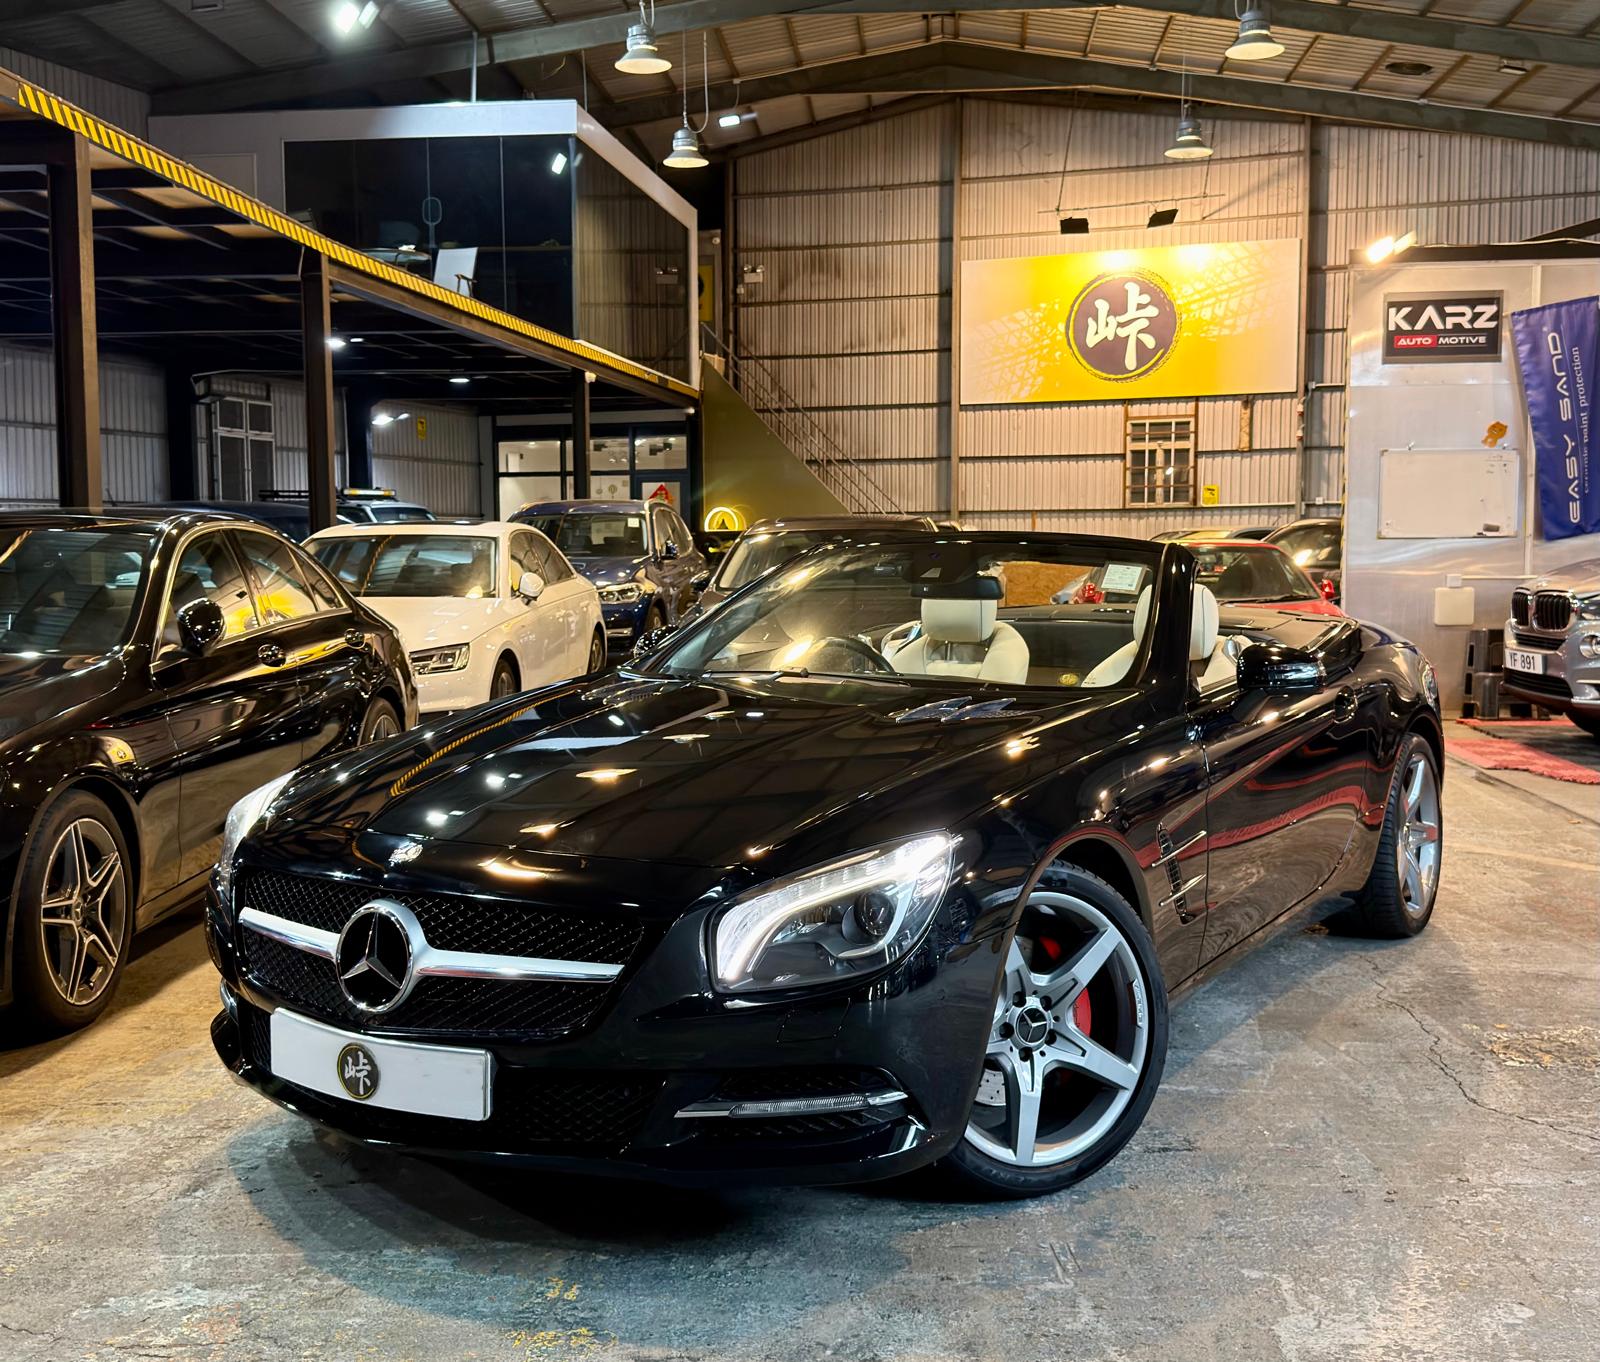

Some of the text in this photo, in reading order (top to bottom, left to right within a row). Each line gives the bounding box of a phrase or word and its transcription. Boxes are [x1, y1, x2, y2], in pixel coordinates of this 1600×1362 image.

[1085, 281, 1159, 371] 峠
[1388, 305, 1498, 331] KARZ
[1397, 336, 1487, 346] AUTO MOTIVE
[1571, 346, 1589, 408] protection
[1547, 332, 1580, 523] EASY SAND
[1520, 654, 1536, 671] 891
[344, 1051, 372, 1095] 峠
